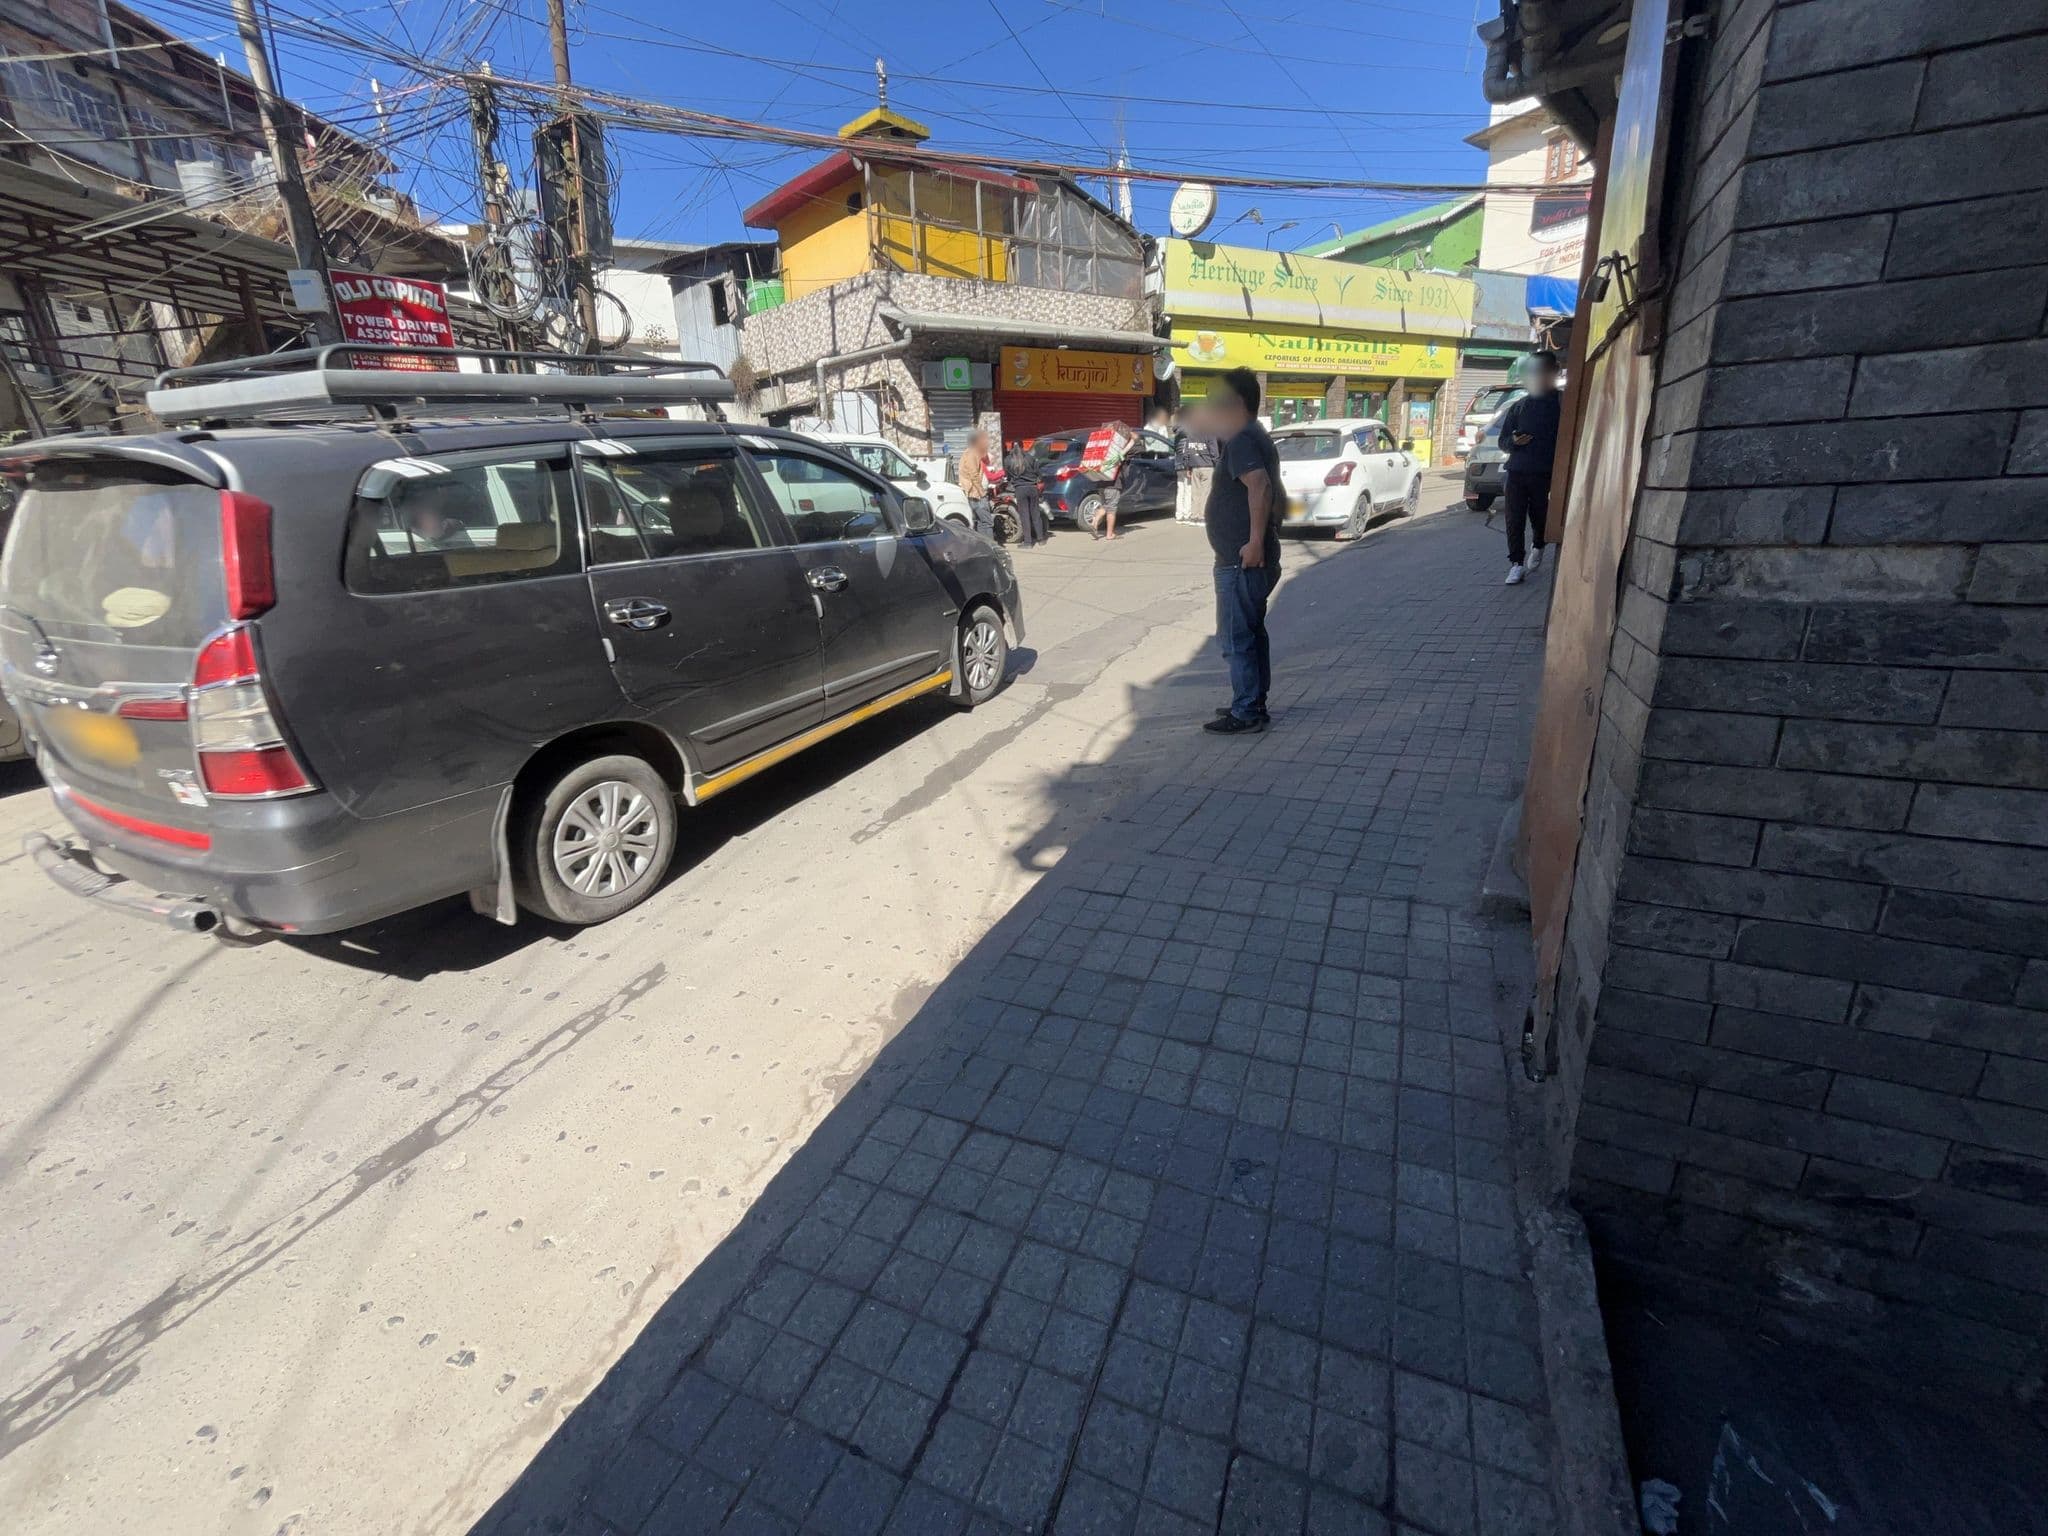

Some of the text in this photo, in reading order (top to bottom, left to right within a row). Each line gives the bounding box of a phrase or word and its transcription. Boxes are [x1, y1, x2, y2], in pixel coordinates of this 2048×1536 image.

[1187, 251, 1451, 310] Heritage Store Since 1931
[334, 279, 445, 313] OLD CAPITAL
[343, 313, 449, 334] TOWER DRIVER
[357, 327, 438, 345] ASSOCIATION
[1252, 332, 1400, 355] Nathmulls
[1264, 354, 1300, 363] EXPORTERS
[1303, 355, 1312, 363] OF
[1314, 356, 1335, 364] EXOTIC
